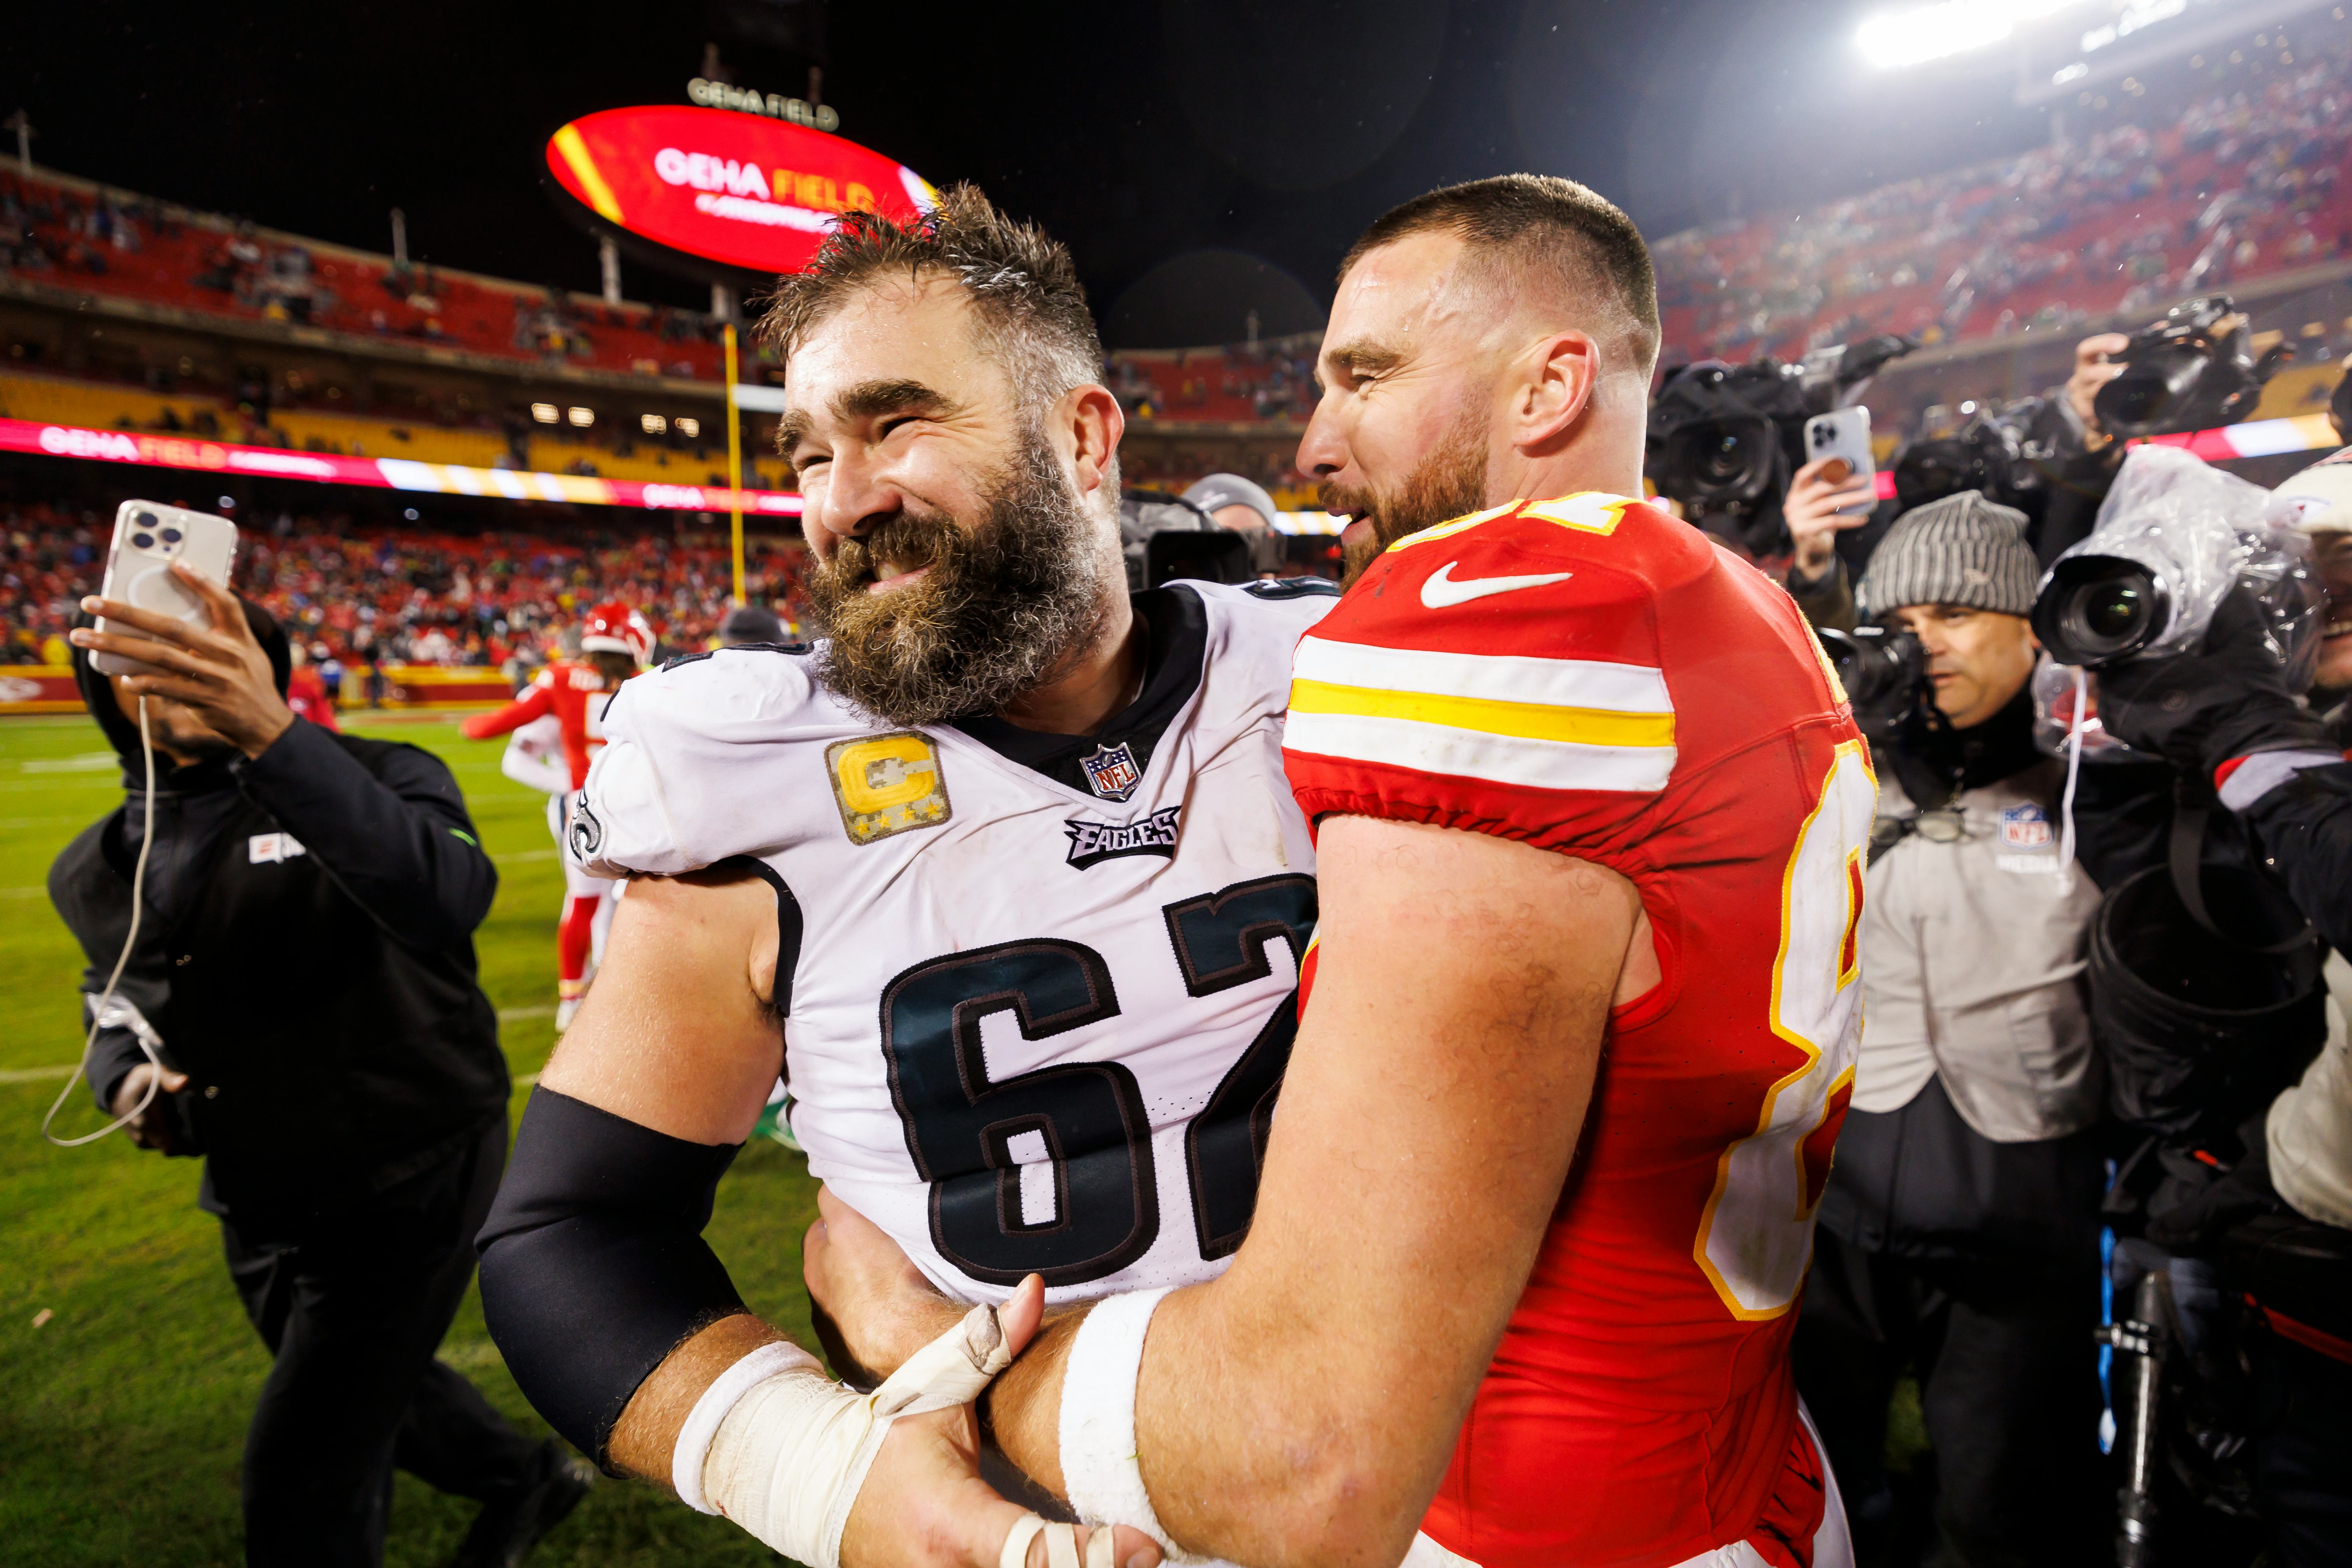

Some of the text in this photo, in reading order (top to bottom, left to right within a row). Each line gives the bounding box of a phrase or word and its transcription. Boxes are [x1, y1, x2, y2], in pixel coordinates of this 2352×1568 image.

[687, 77, 839, 132] GEHA FIELD
[654, 147, 770, 200] GEHA
[772, 168, 875, 214] FIELD
[39, 426, 140, 462] GEHA
[837, 737, 936, 814] C
[1095, 763, 1136, 790] NFL
[1064, 806, 1181, 862] EAGLES
[2006, 822, 2050, 843] NFL
[878, 872, 1319, 1288] 62
